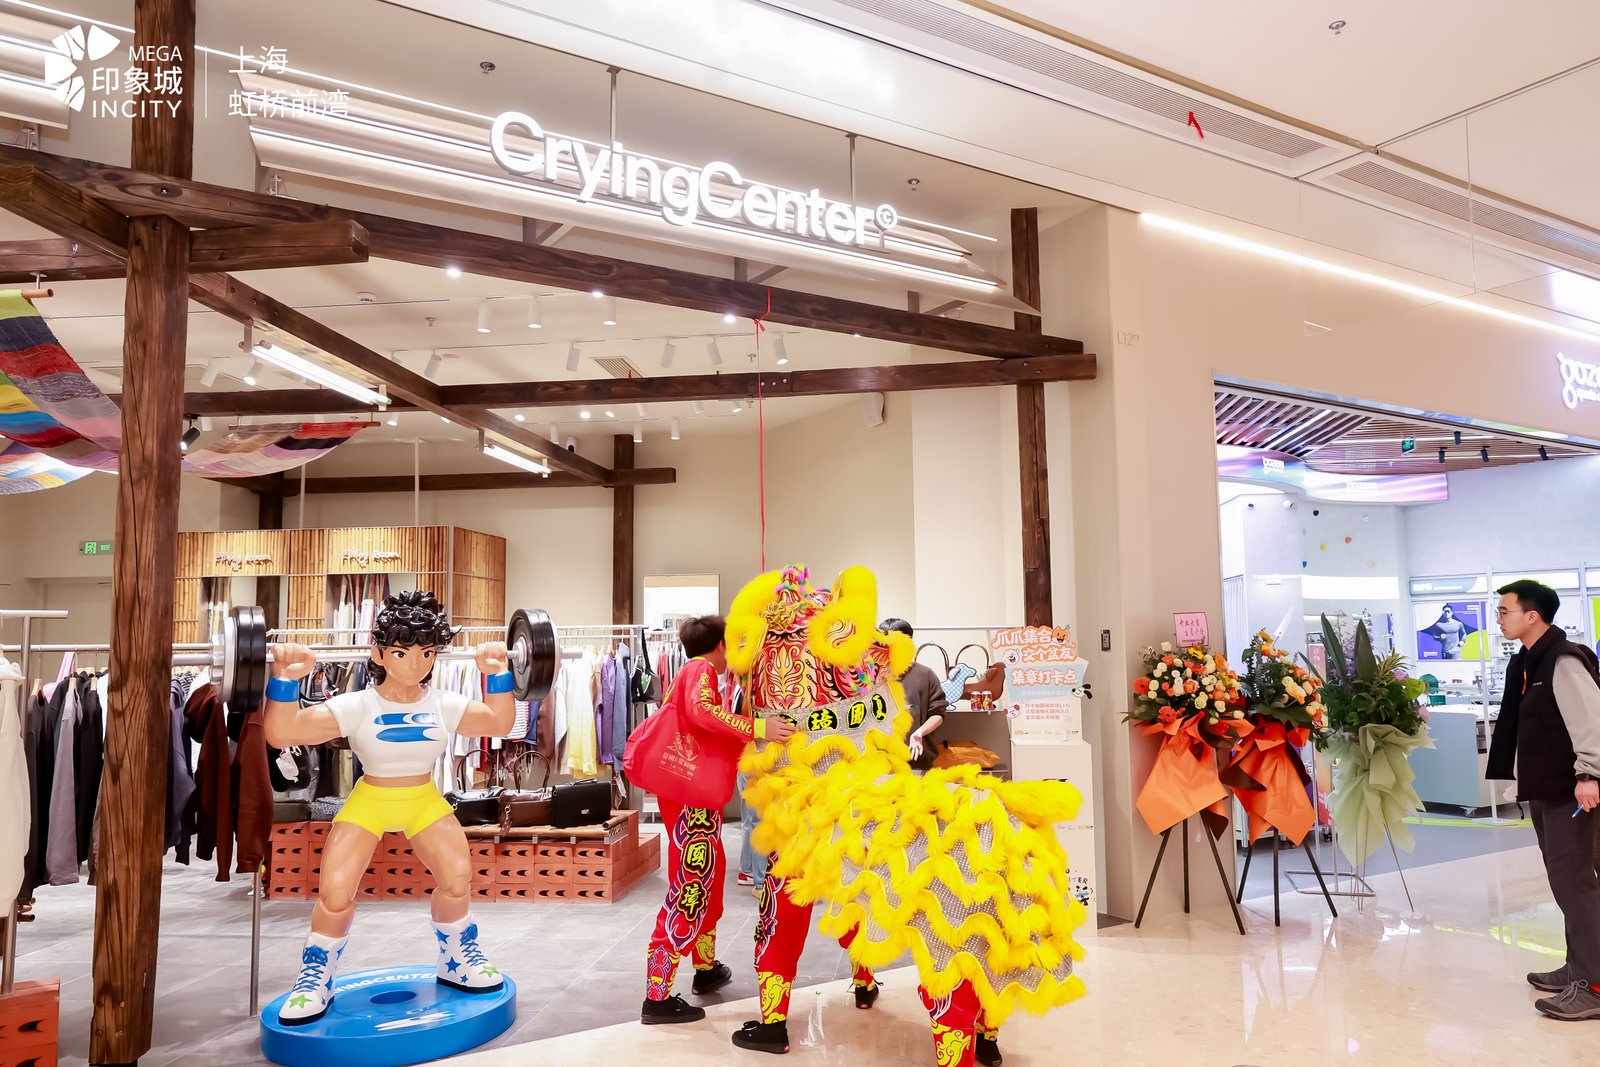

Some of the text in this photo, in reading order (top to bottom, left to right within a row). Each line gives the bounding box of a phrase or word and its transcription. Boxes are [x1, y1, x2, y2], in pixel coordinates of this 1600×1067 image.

[1556, 352, 1600, 409] goz
[1011, 668, 1078, 686] 集章打卡点
[712, 705, 753, 735] CHEUNG
